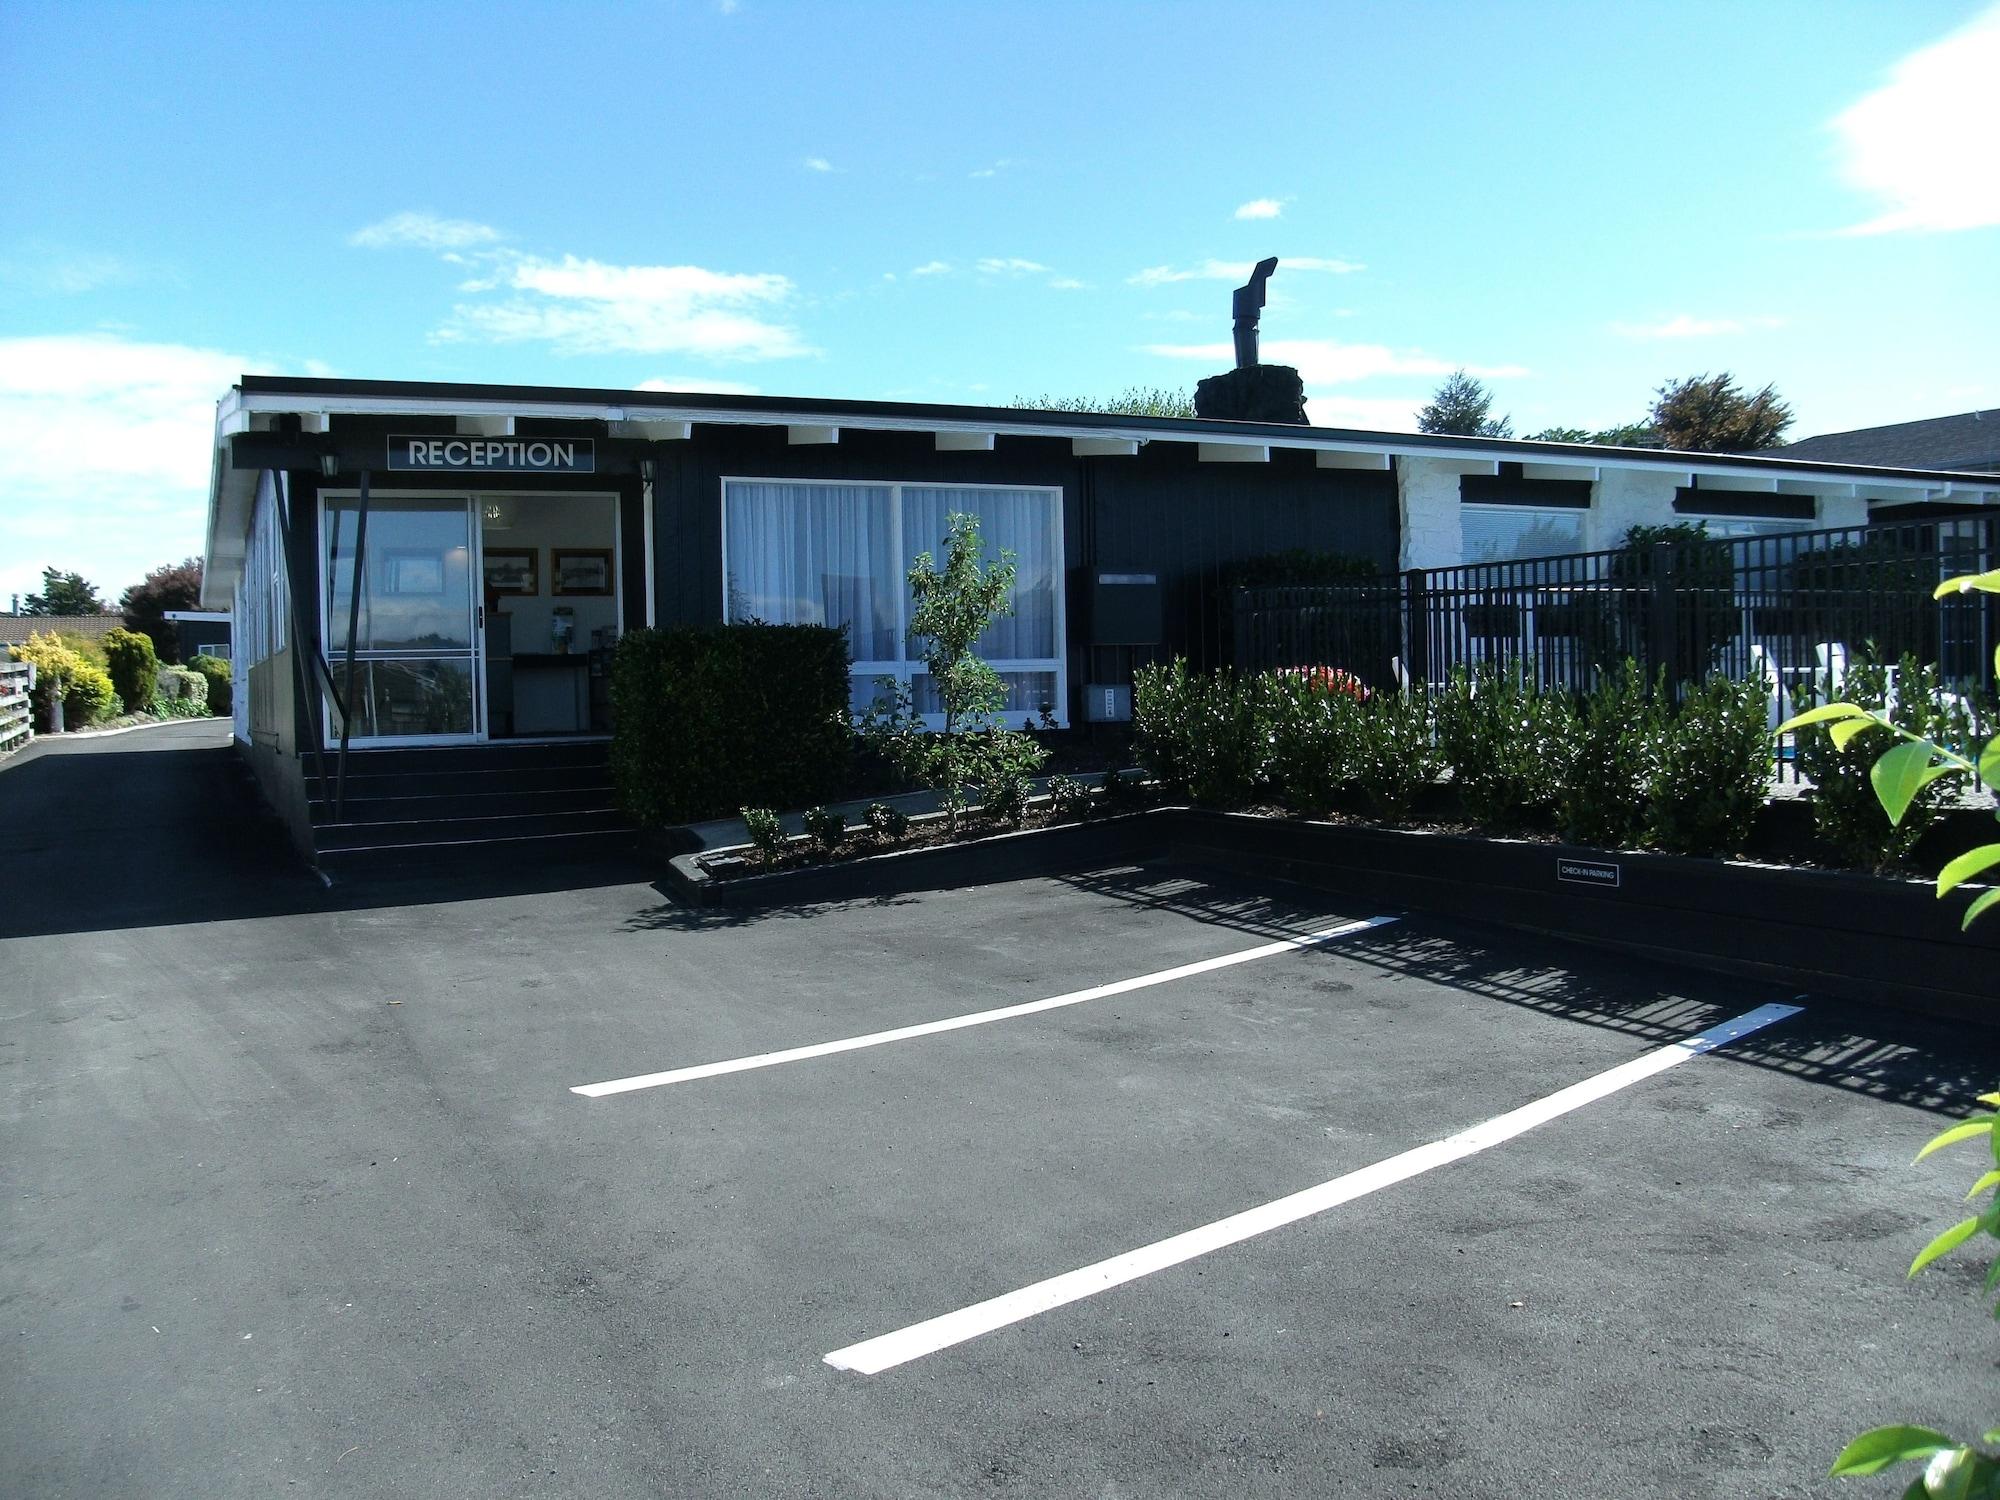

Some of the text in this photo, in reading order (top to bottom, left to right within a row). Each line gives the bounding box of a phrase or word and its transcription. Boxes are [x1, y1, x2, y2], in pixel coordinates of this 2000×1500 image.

[409, 441, 574, 467] RECEPTION
[1561, 866, 1615, 879] CHECK-IN PARKING
